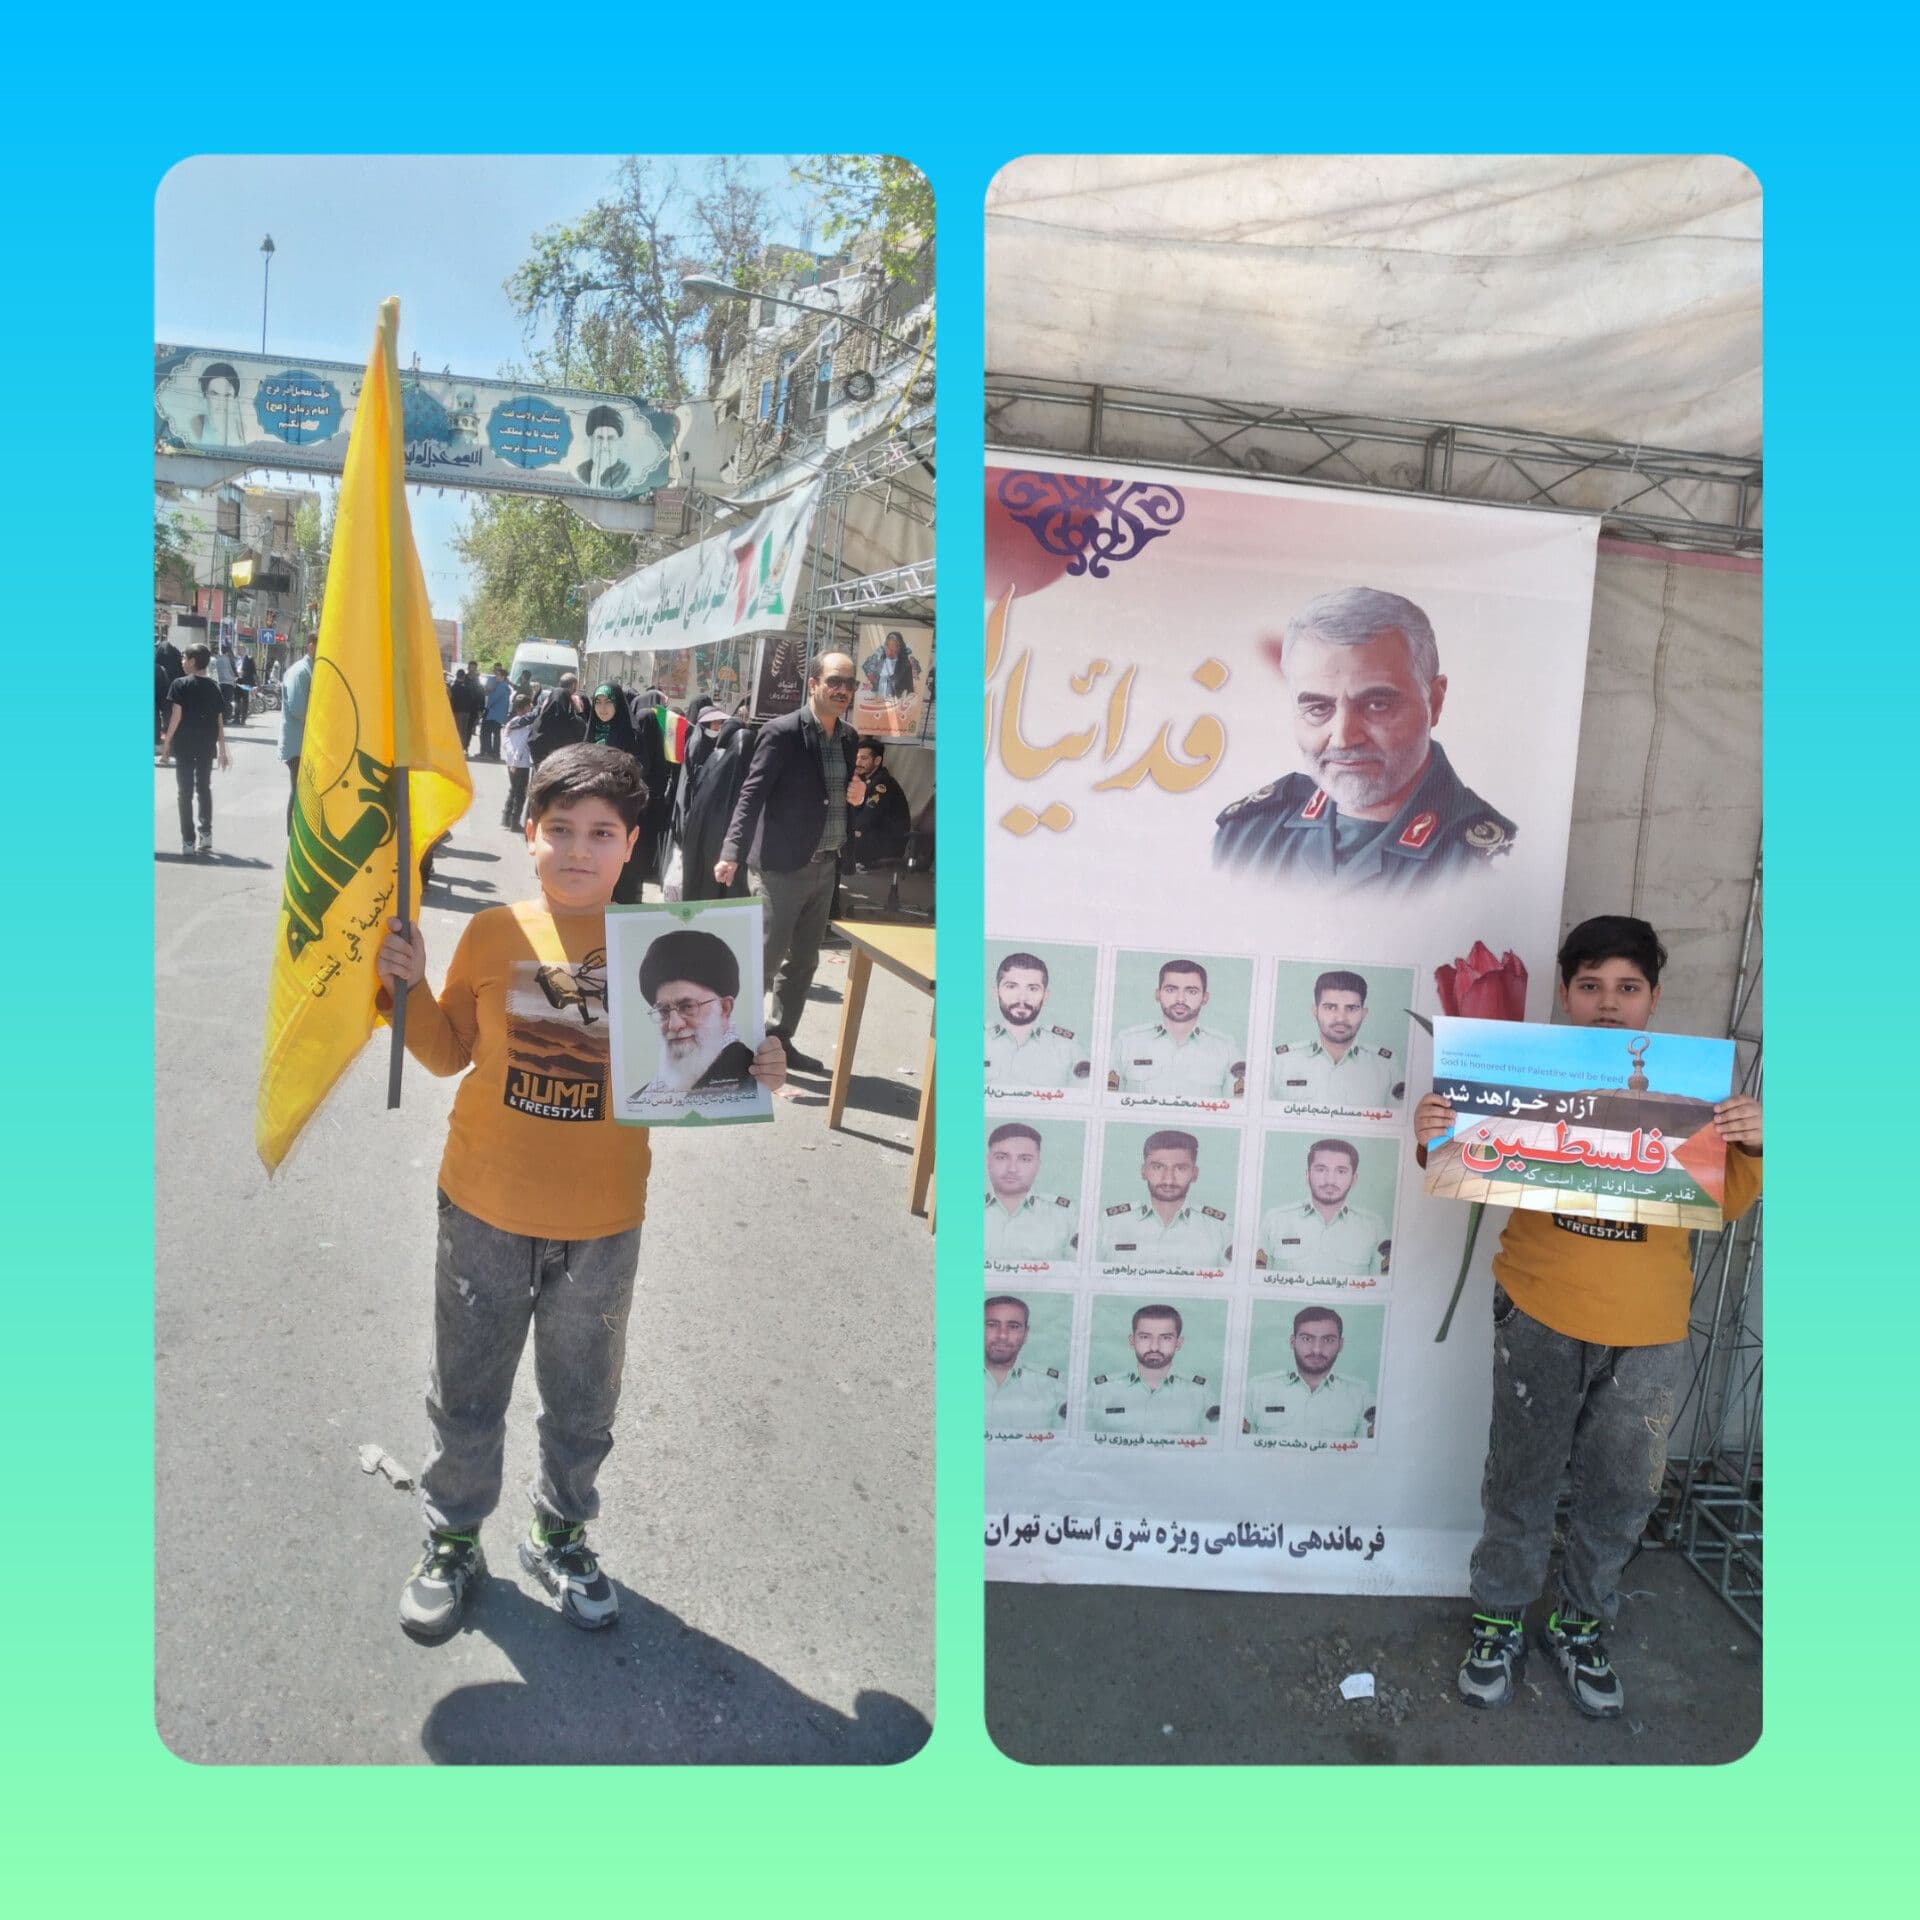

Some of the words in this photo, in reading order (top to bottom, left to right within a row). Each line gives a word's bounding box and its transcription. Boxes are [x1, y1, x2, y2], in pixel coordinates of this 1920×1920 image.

[311, 406, 329, 416] امام
[1440, 1057, 1459, 1067] God
[1469, 1060, 1506, 1073] honored
[1507, 1065, 1526, 1075] that
[1527, 1066, 1568, 1078] Palestine
[1569, 1070, 1585, 1080] will
[1585, 1071, 1598, 1082] be
[1600, 1073, 1625, 1085] freed
[511, 1071, 599, 1108] JUMP
[994, 1087, 1032, 1099] حسن
[1032, 1088, 1064, 1101] شهید
[1442, 1084, 1471, 1103] شد
[518, 1098, 595, 1119] FREESTYLE
[1197, 1099, 1230, 1111] شهید
[1475, 1089, 1549, 1116] خواهد
[1555, 1096, 1598, 1120] آزاد
[1283, 1104, 1331, 1116] شجاعیان
[1330, 1107, 1362, 1118] مسلم
[1362, 1109, 1393, 1121] شهید
[1461, 1119, 1669, 1175] فلسطین
[1523, 1167, 1537, 1181] که
[1543, 1173, 1574, 1185] است
[1576, 1176, 1599, 1192] این
[1601, 1180, 1657, 1196] خداوند
[1661, 1188, 1696, 1203] تقدیر
[1566, 1219, 1638, 1240] FREESTYLE
[993, 1261, 1019, 1273] پوریا
[1020, 1261, 1050, 1272] شهید
[1138, 1266, 1166, 1276] حسن
[1195, 1269, 1224, 1279] شهید
[1263, 1275, 1305, 1286] شهریاری
[1306, 1276, 1348, 1289] ابوالفضل
[1349, 1278, 1377, 1289] شهید
[994, 1432, 1023, 1443] حمید
[1025, 1431, 1055, 1442] شهید
[1094, 1432, 1107, 1443] نیا
[1108, 1434, 1145, 1447] فیروزی
[1146, 1436, 1176, 1448] مجید
[1177, 1436, 1208, 1447] شهید
[1278, 1438, 1308, 1449] دشت
[1309, 1441, 1328, 1452] علی
[1329, 1440, 1359, 1452] شهید
[984, 1513, 1041, 1548] تهران
[1044, 1515, 1101, 1545] استان
[1104, 1518, 1151, 1552] شرق
[1154, 1519, 1200, 1554] ویژه
[1204, 1519, 1284, 1555] انتظامی
[1287, 1523, 1386, 1561] فرماندهی
